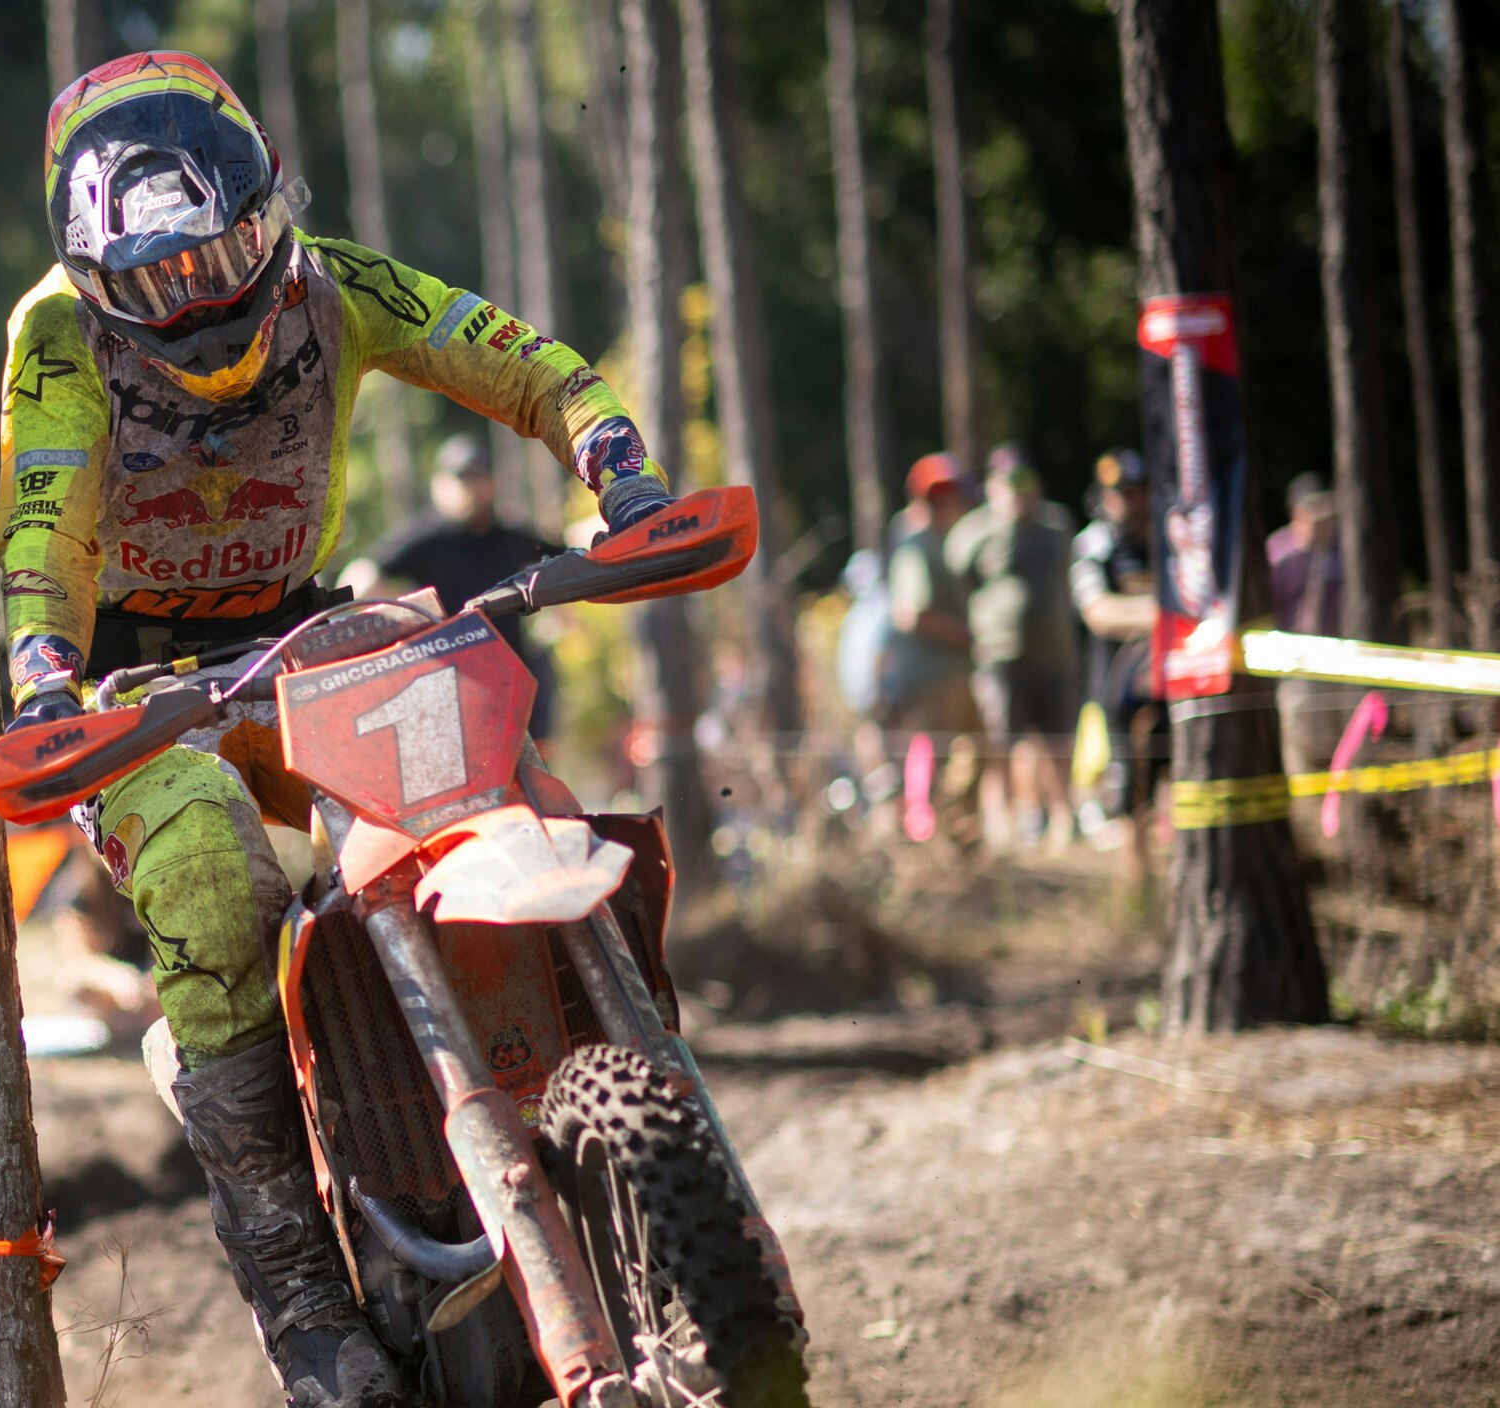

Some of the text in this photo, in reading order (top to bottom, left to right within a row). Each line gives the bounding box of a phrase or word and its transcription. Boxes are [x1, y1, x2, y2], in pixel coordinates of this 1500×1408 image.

[463, 304, 498, 345] WP
[487, 319, 530, 353] RK
[648, 514, 700, 543] KTM
[120, 523, 307, 582] Red Bull
[112, 572, 292, 620] KTM
[319, 627, 490, 692] GNCCRACING.COM
[35, 726, 87, 760] KTM
[355, 665, 469, 805] 1
